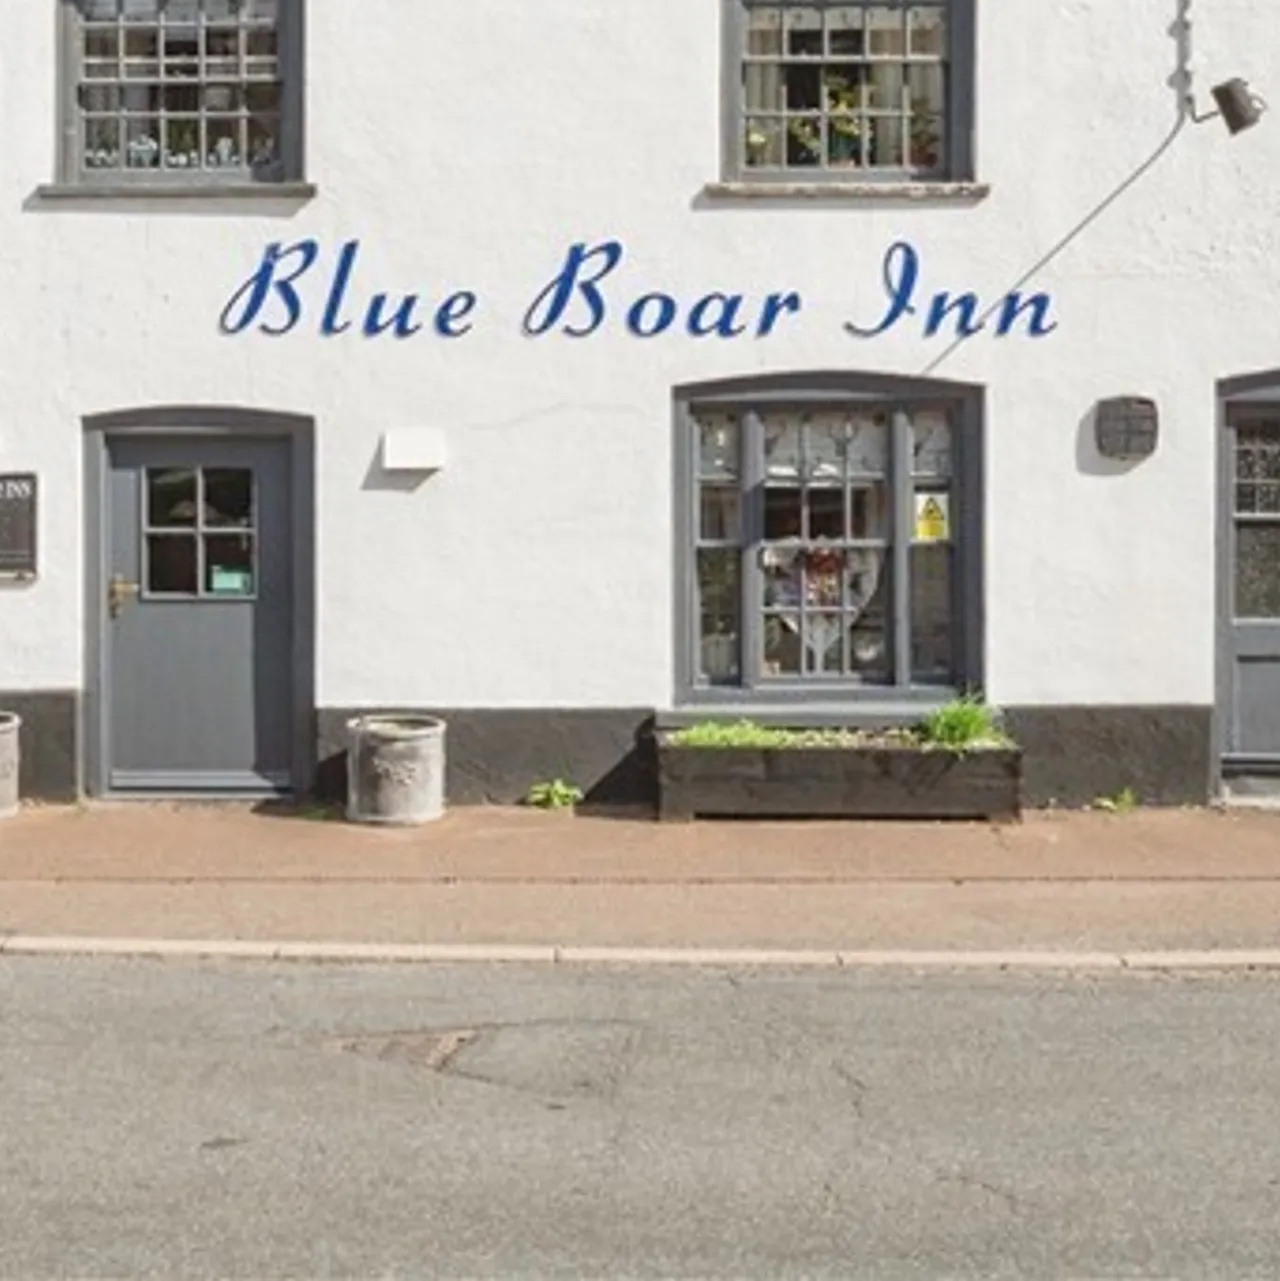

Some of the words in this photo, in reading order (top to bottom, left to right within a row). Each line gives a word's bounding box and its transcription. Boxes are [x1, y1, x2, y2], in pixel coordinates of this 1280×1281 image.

[218, 238, 477, 338] Blue
[523, 238, 802, 340] Boar
[843, 241, 1059, 338] Inn
